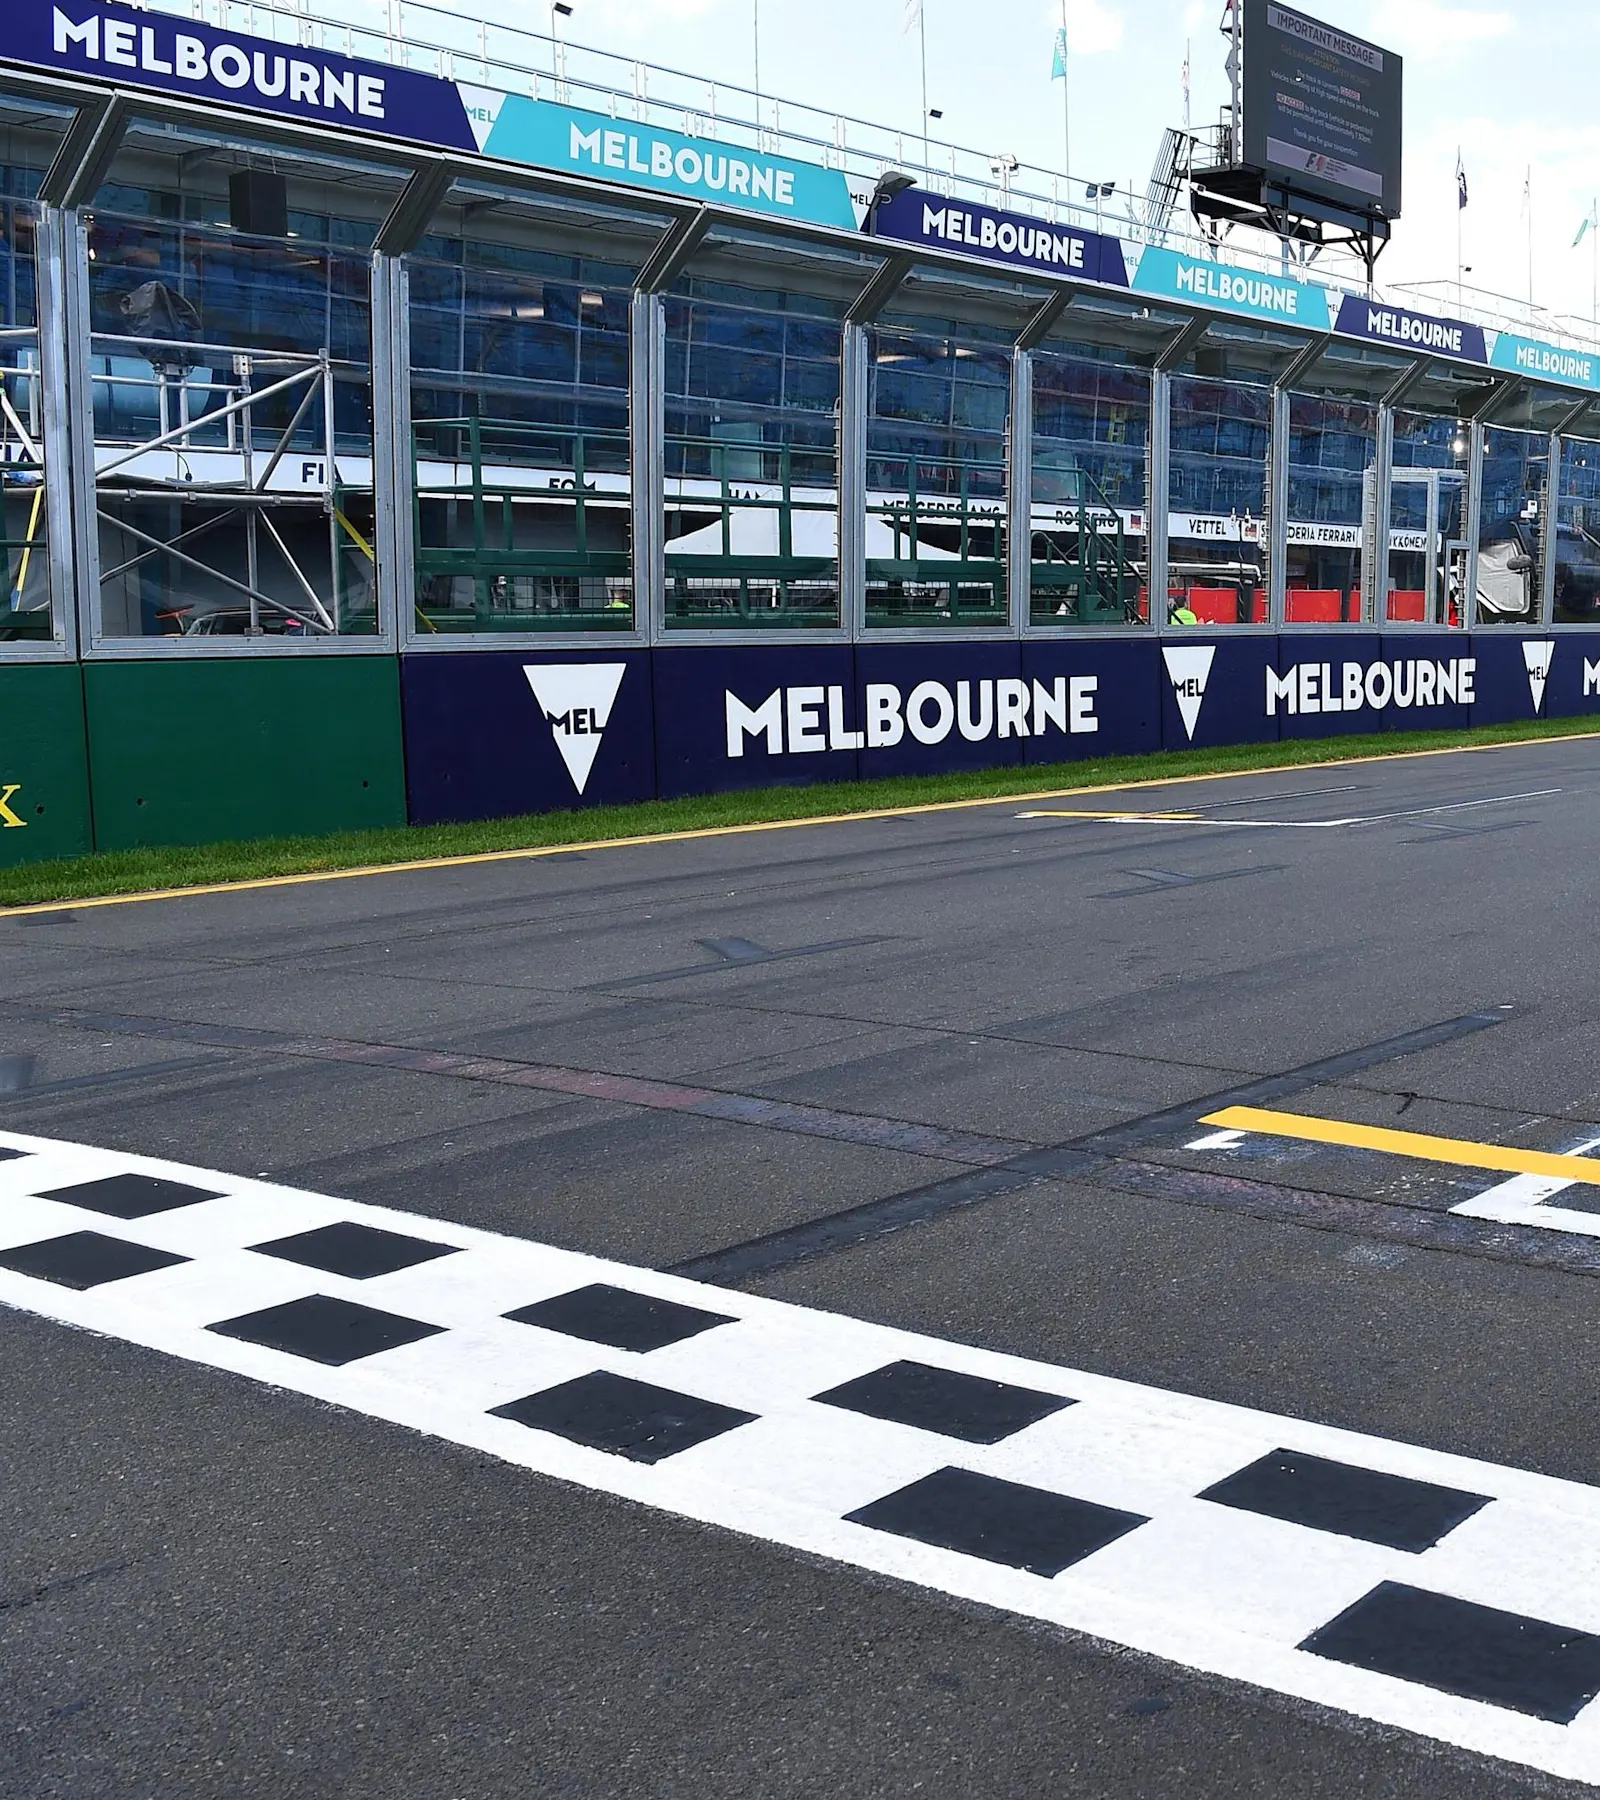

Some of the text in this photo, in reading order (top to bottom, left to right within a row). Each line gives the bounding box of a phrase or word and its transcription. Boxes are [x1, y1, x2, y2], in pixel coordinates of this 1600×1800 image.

[1277, 12, 1331, 47] IMPORTANT
[1333, 35, 1373, 65] MESSAGE
[53, 5, 386, 119] MELBOURNE
[465, 104, 496, 123] MEL
[569, 120, 796, 206] MELBOURNE
[850, 192, 871, 206] MEL
[922, 201, 1085, 269] MELBOURNE
[1124, 255, 1139, 268] MEL
[1176, 260, 1298, 316] MELBOURNE
[1366, 307, 1463, 352] MELBOURNE
[1516, 344, 1591, 381] MELBOURNE
[1189, 519, 1227, 535] VETTEL
[1318, 528, 1356, 543] FERRARI
[1173, 677, 1204, 698] MEL
[1265, 657, 1477, 716] MELBOURNE
[1528, 665, 1546, 680] MEL
[546, 706, 601, 736] MEL
[725, 675, 1098, 758] MELBOURNE
